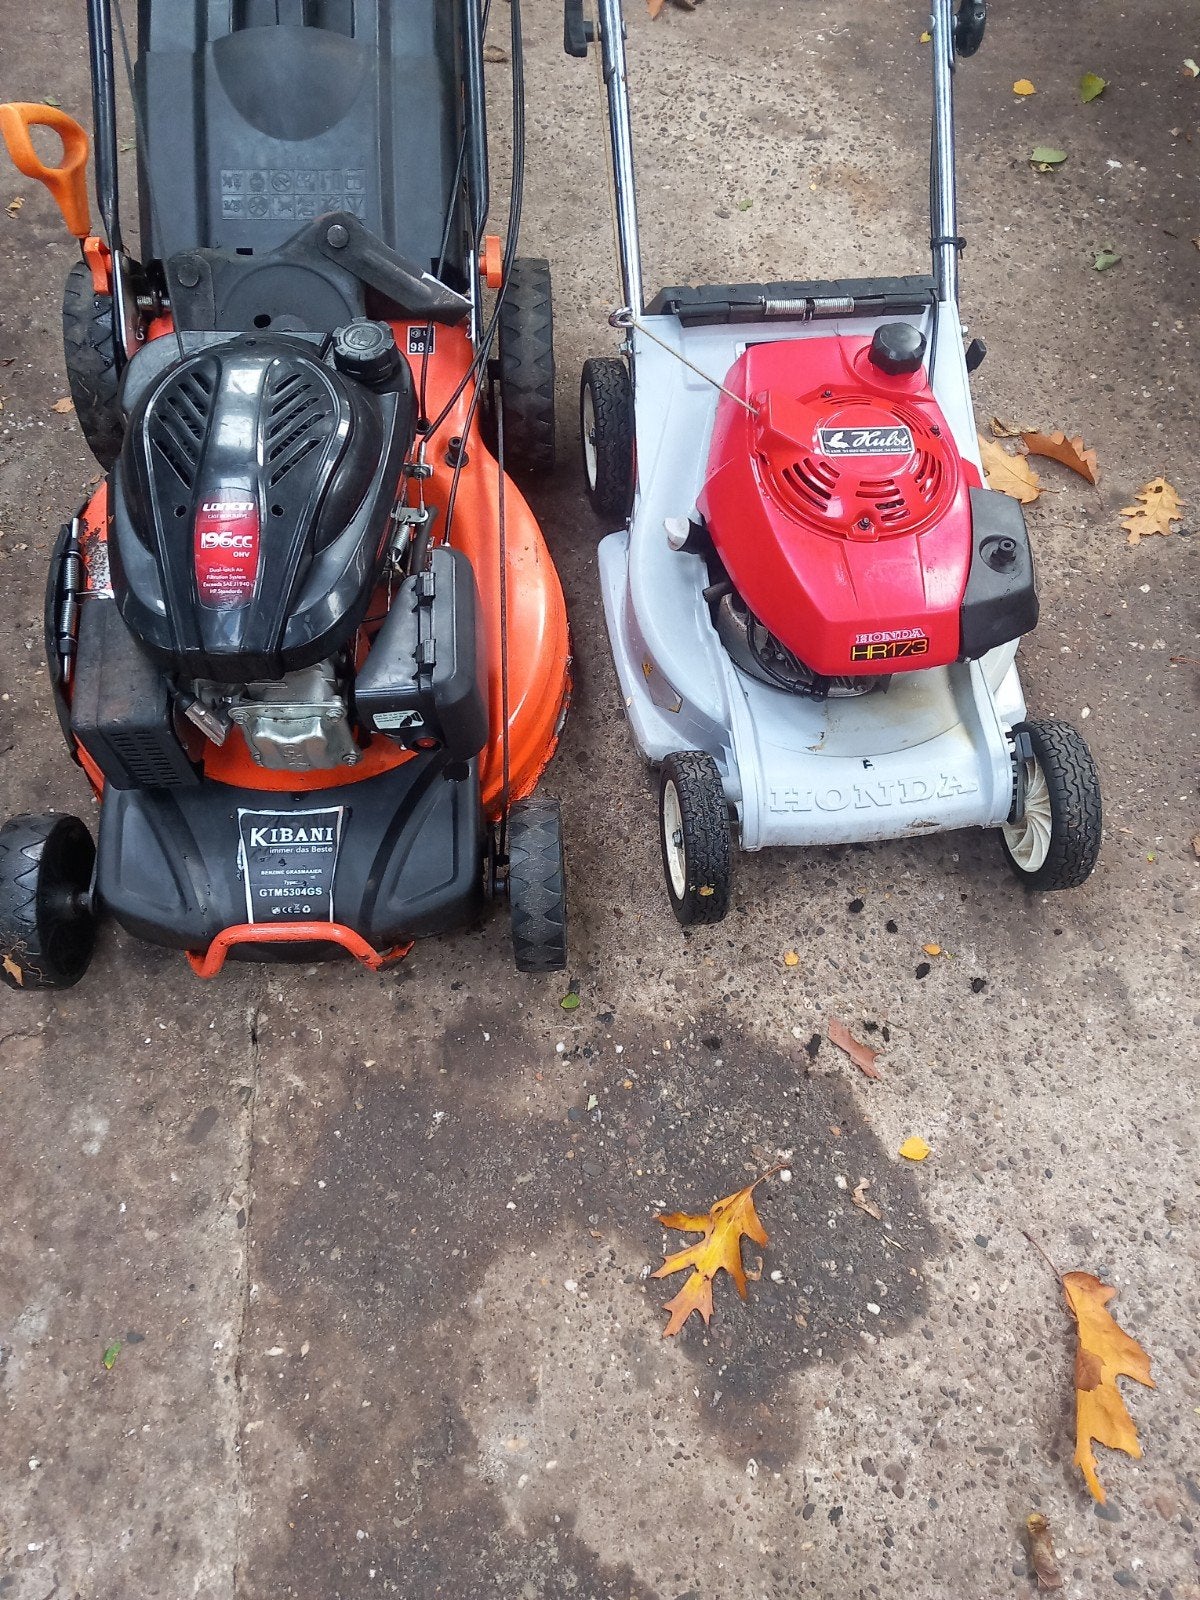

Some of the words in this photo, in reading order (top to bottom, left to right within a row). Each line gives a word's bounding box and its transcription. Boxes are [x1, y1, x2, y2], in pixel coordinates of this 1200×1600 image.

[410, 342, 425, 352] 98
[851, 430, 910, 447] Hulst
[201, 531, 253, 549] 196cc
[855, 628, 926, 644] HONDA
[851, 639, 928, 661] HR173
[770, 773, 978, 813] HONDA
[250, 827, 334, 847] KIBANI
[259, 887, 323, 897] GTM5304GS
